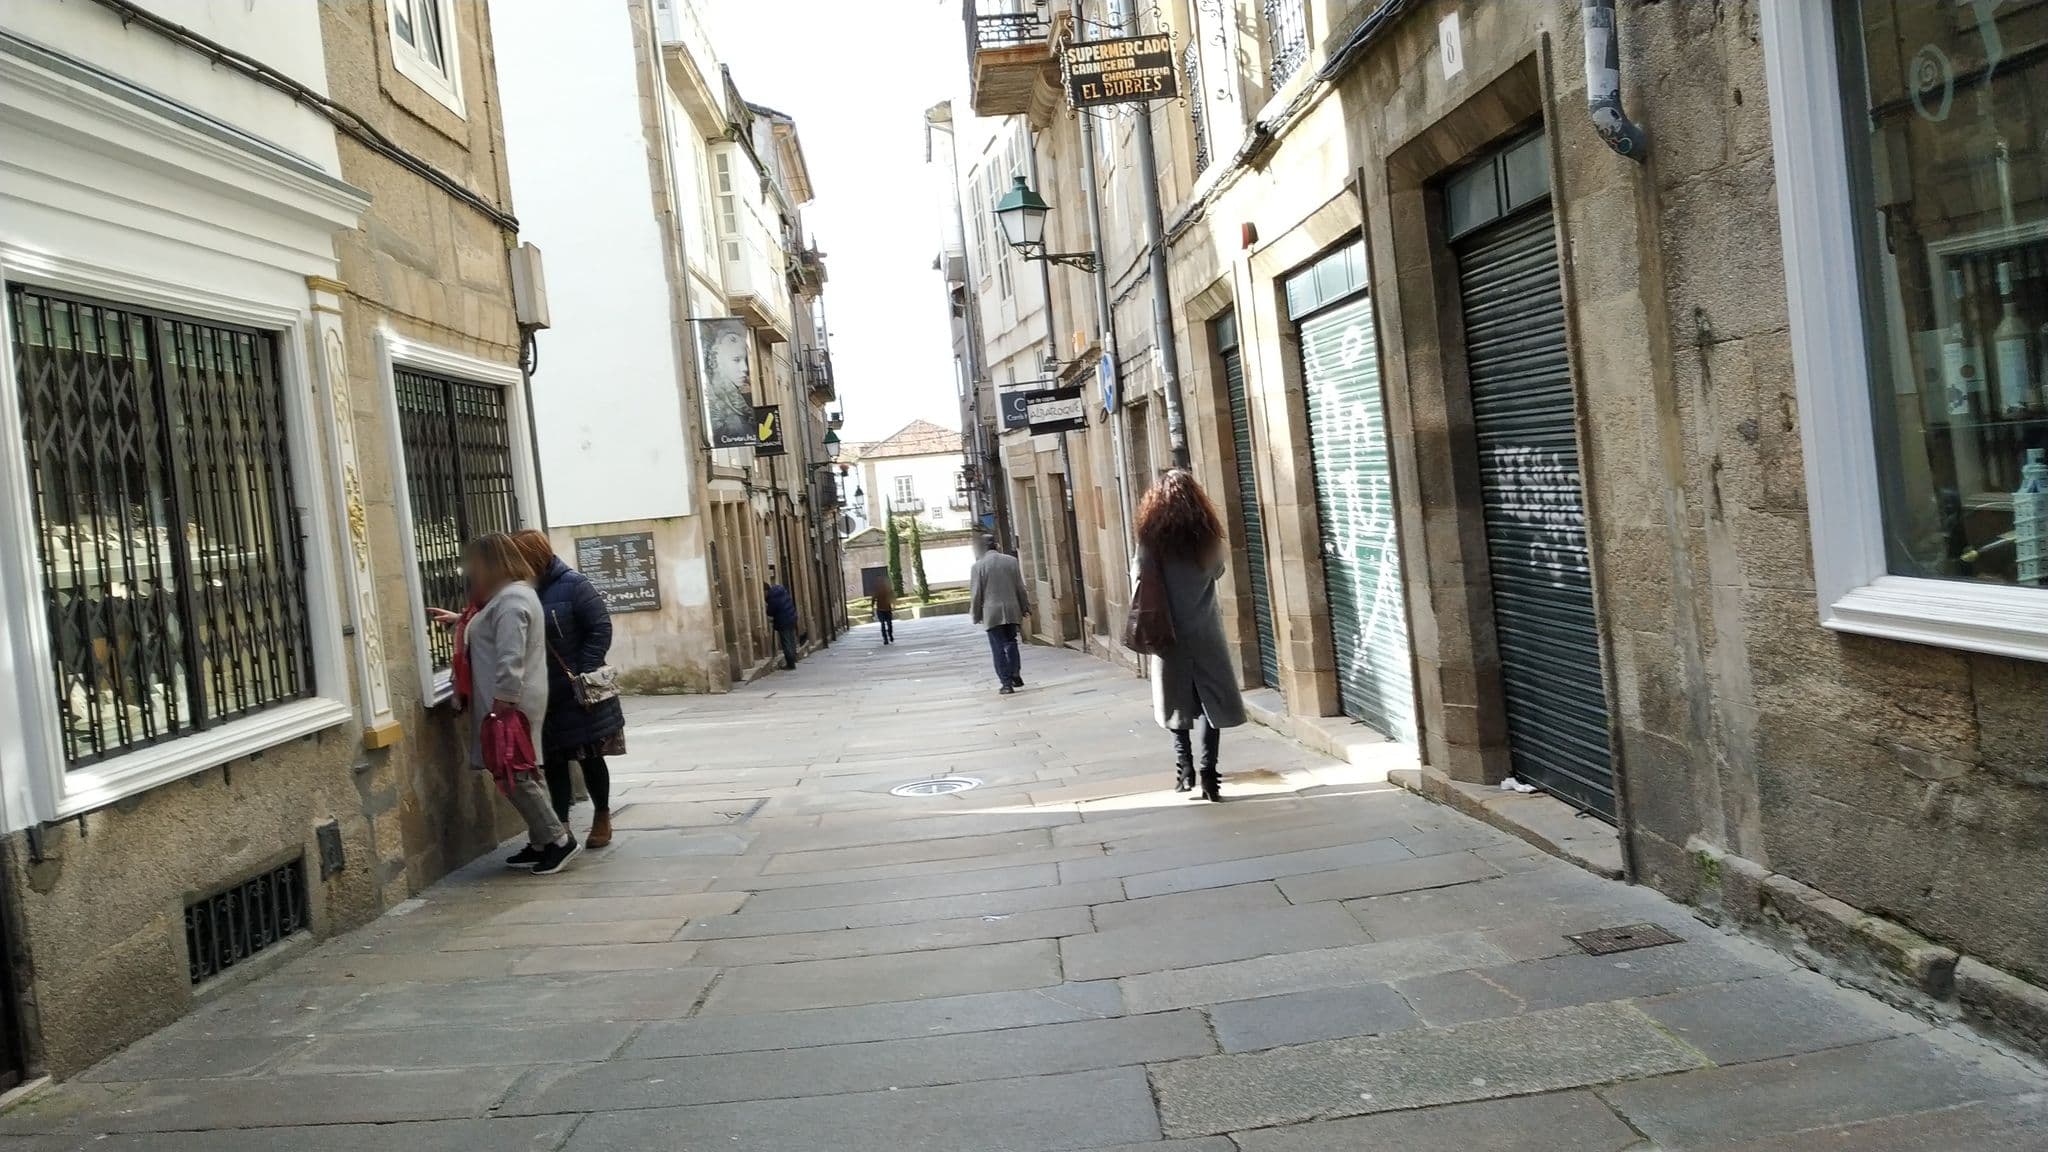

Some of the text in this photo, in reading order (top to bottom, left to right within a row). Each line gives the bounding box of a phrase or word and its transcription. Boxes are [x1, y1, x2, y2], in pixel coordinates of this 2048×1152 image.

[1067, 38, 1169, 63] SUPERMERCADO
[1446, 31, 1455, 64] 8
[1071, 57, 1136, 76] CARNICERIA
[1102, 66, 1171, 82] CHARCUTERIA
[1082, 76, 1162, 100] EL DUBRES
